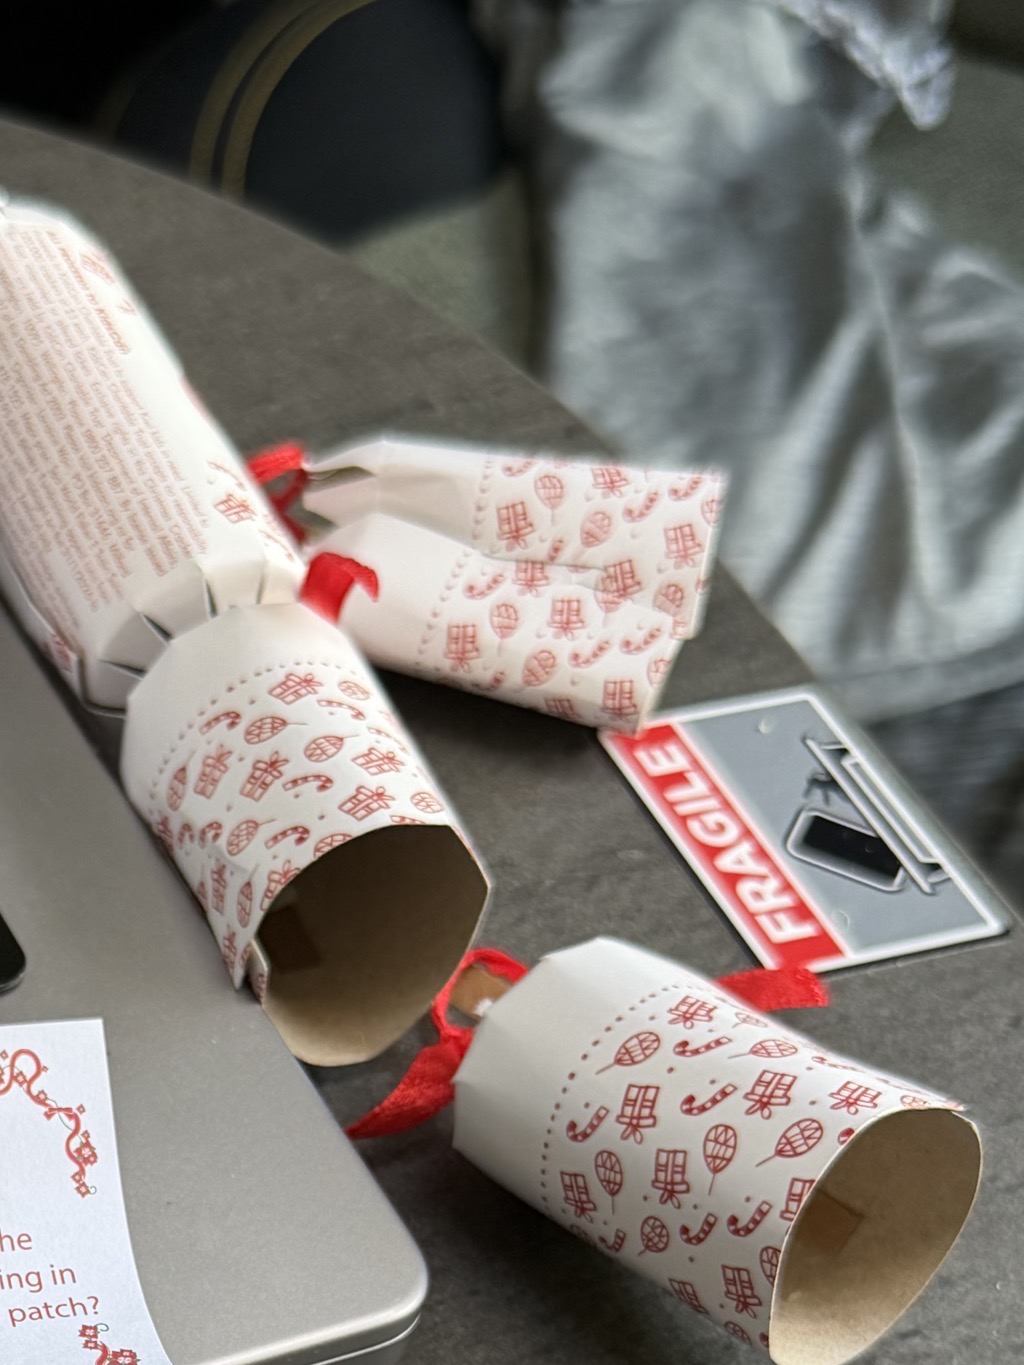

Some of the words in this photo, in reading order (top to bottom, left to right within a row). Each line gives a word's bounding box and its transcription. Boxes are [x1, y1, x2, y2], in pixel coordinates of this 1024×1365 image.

[632, 742, 819, 944] FRAGILE
[50, 1264, 77, 1286] in
[8, 1295, 100, 1328] patch?
